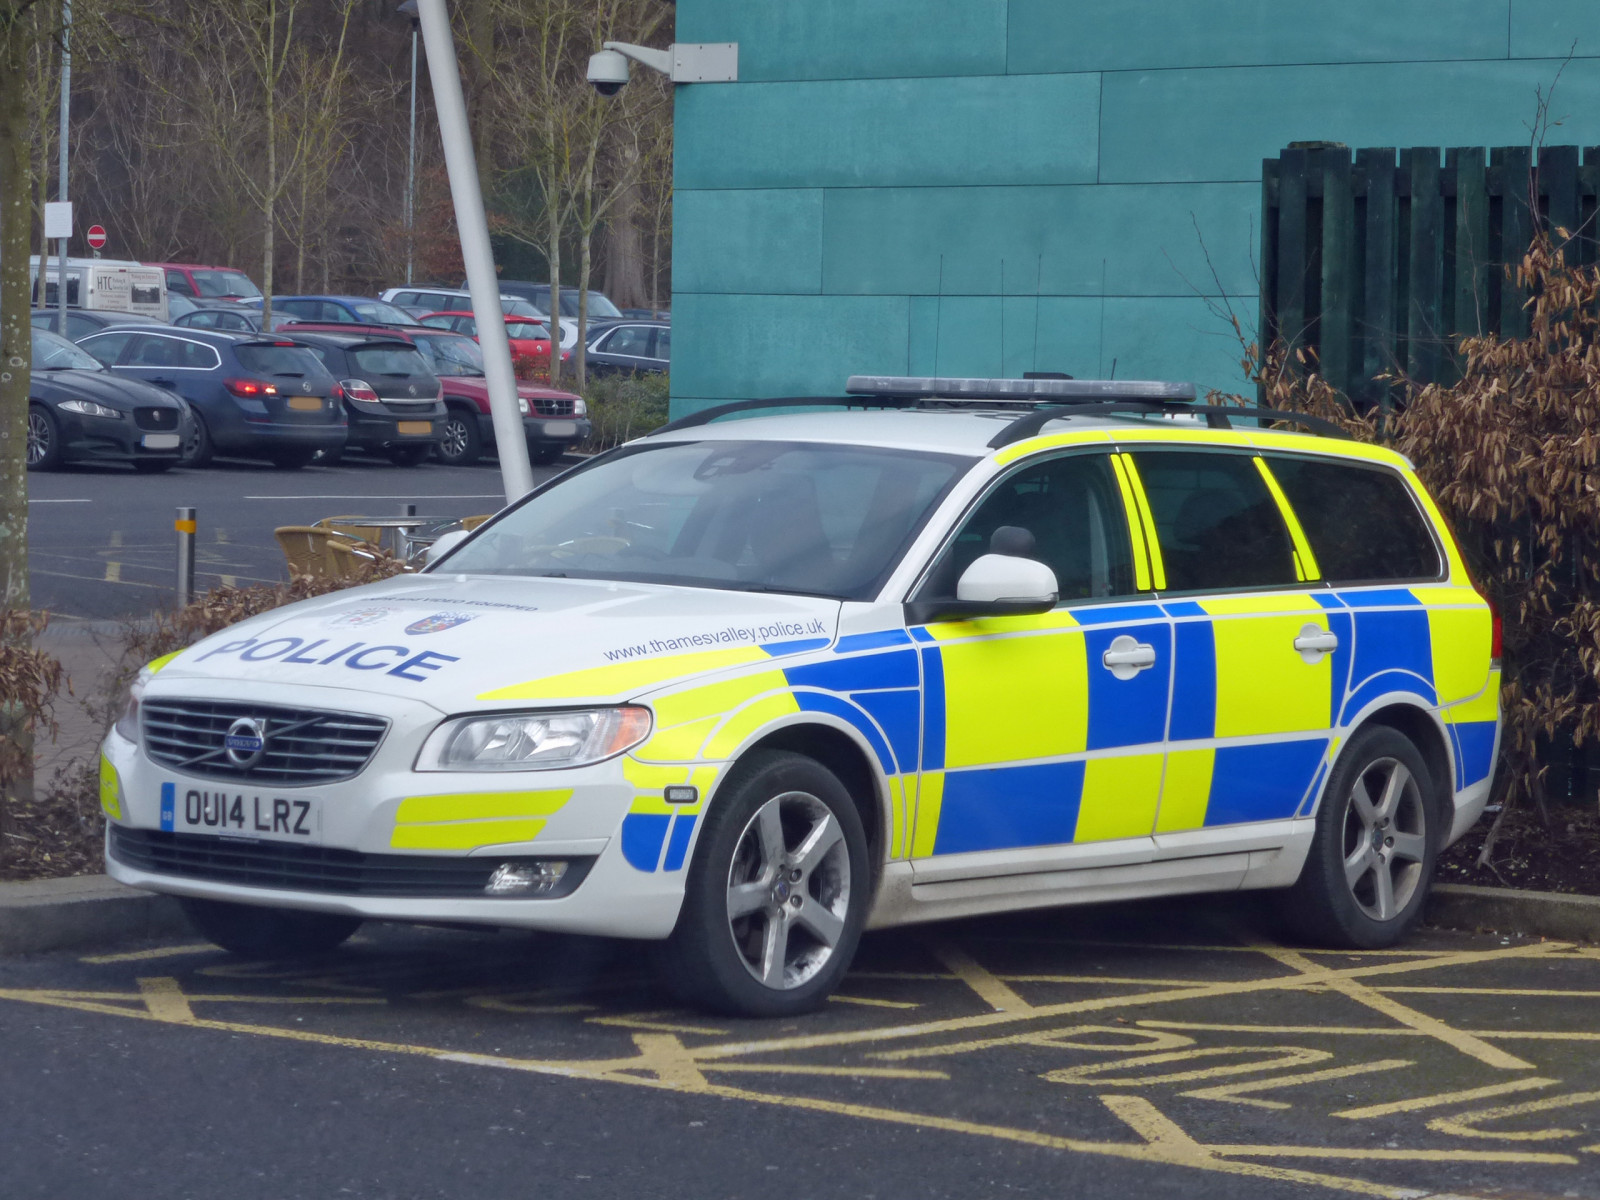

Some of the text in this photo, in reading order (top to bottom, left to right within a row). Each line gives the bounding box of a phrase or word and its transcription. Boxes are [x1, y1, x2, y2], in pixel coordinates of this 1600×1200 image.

[97, 276, 112, 290] HTC
[193, 637, 460, 682] POLICE
[603, 618, 826, 661] www.thamesvalley.police.uk
[226, 737, 260, 749] VOLVO
[185, 790, 245, 829] OU14
[254, 797, 311, 835] LRZ
[862, 1024, 1600, 1154] POLIC
